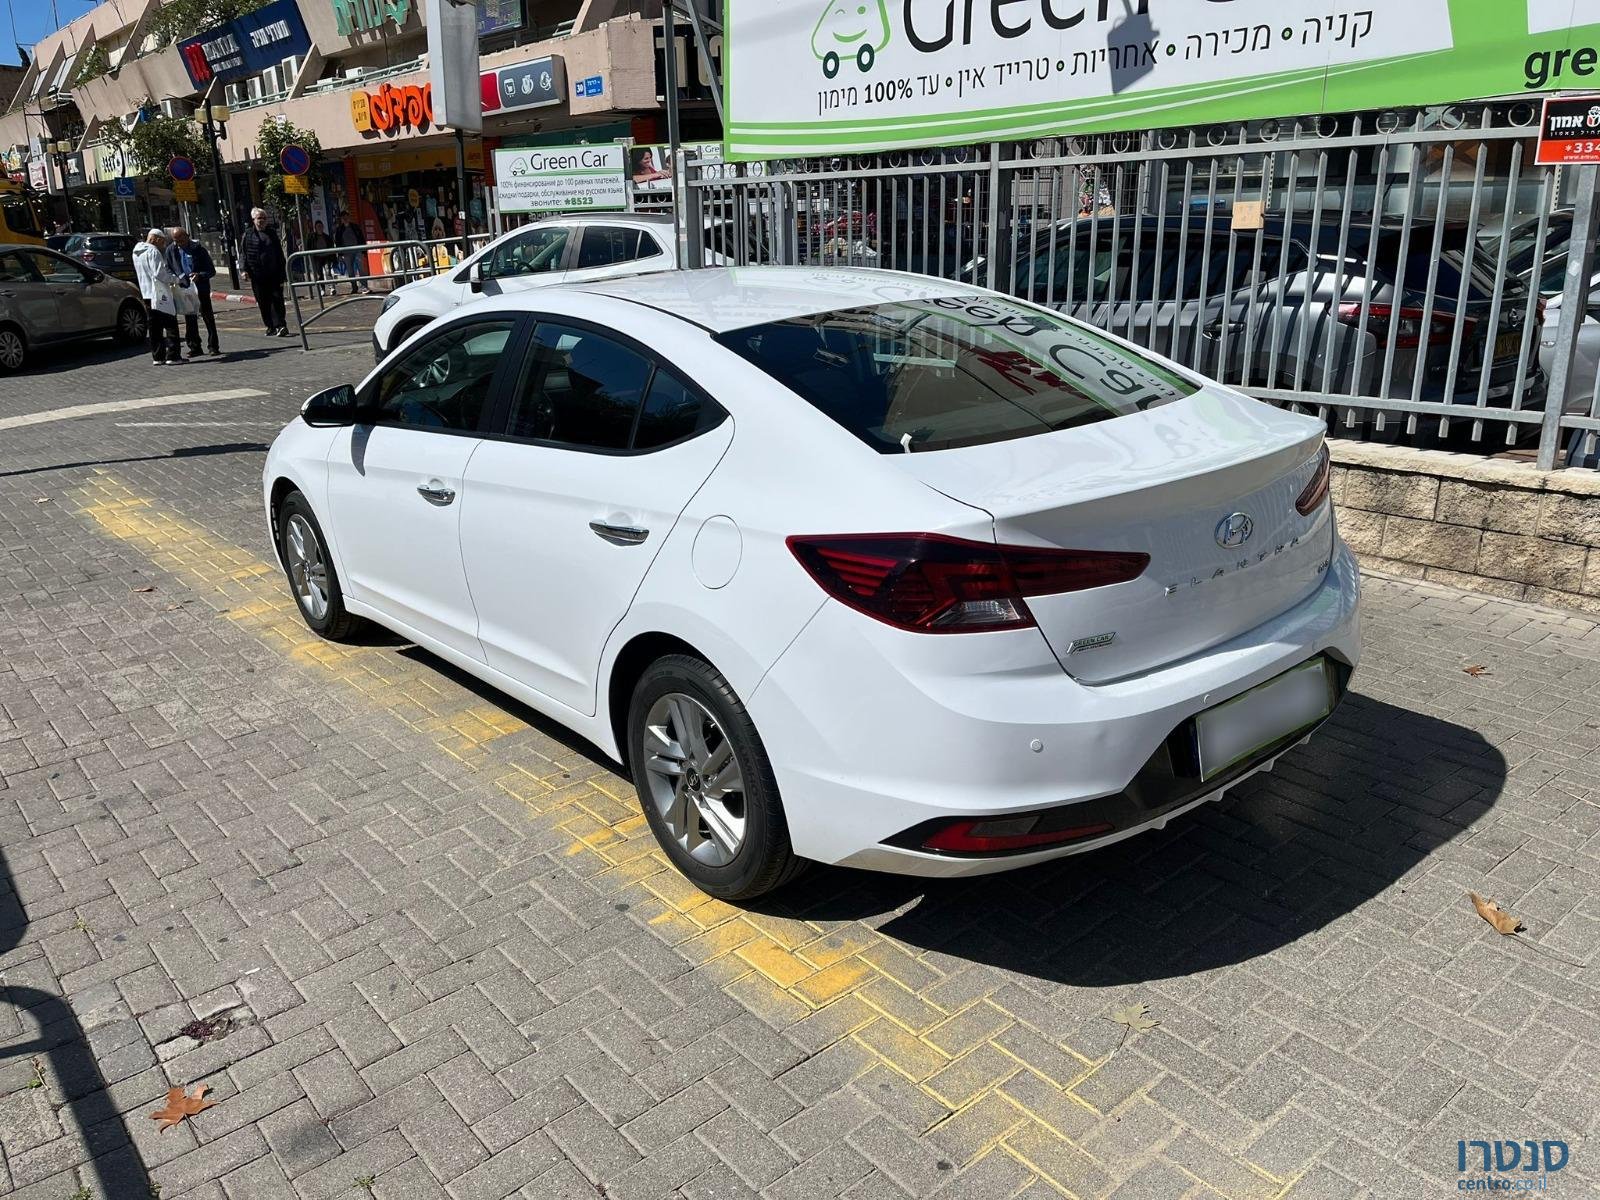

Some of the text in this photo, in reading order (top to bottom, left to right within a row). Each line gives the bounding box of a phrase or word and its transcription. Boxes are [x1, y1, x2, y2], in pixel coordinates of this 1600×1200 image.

[818, 10, 1373, 116] קניה מכירה אחריות טרייד אין עד 100% מימון
[1524, 47, 1598, 89] gre
[1550, 115, 1584, 131] אמון
[530, 150, 609, 170] Green Car
[565, 178, 574, 186] 100
[1163, 536, 1300, 598] ELANTRA
